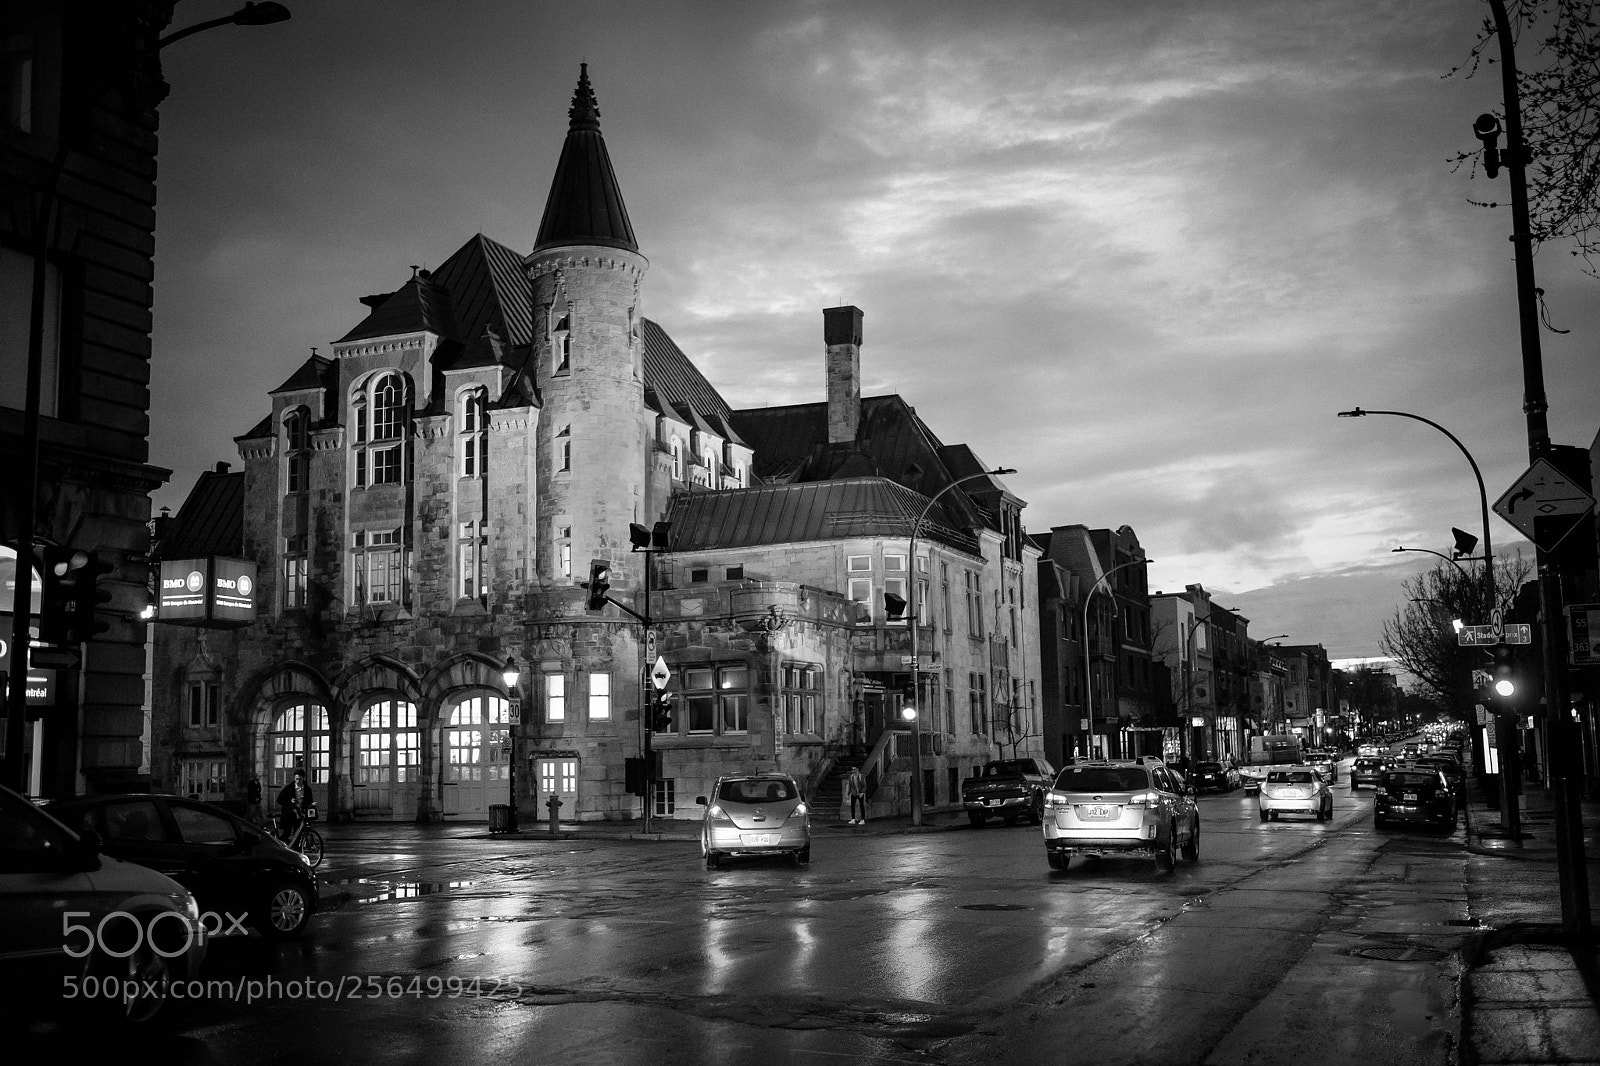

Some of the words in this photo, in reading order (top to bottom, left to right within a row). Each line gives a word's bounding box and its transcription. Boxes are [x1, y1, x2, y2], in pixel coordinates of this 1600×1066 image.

[163, 579, 185, 589] BMO
[217, 578, 236, 589] BMO
[1575, 618, 1587, 628] 55
[1574, 642, 1589, 652] 363
[25, 688, 47, 698] ntréal
[510, 704, 519, 718] 30
